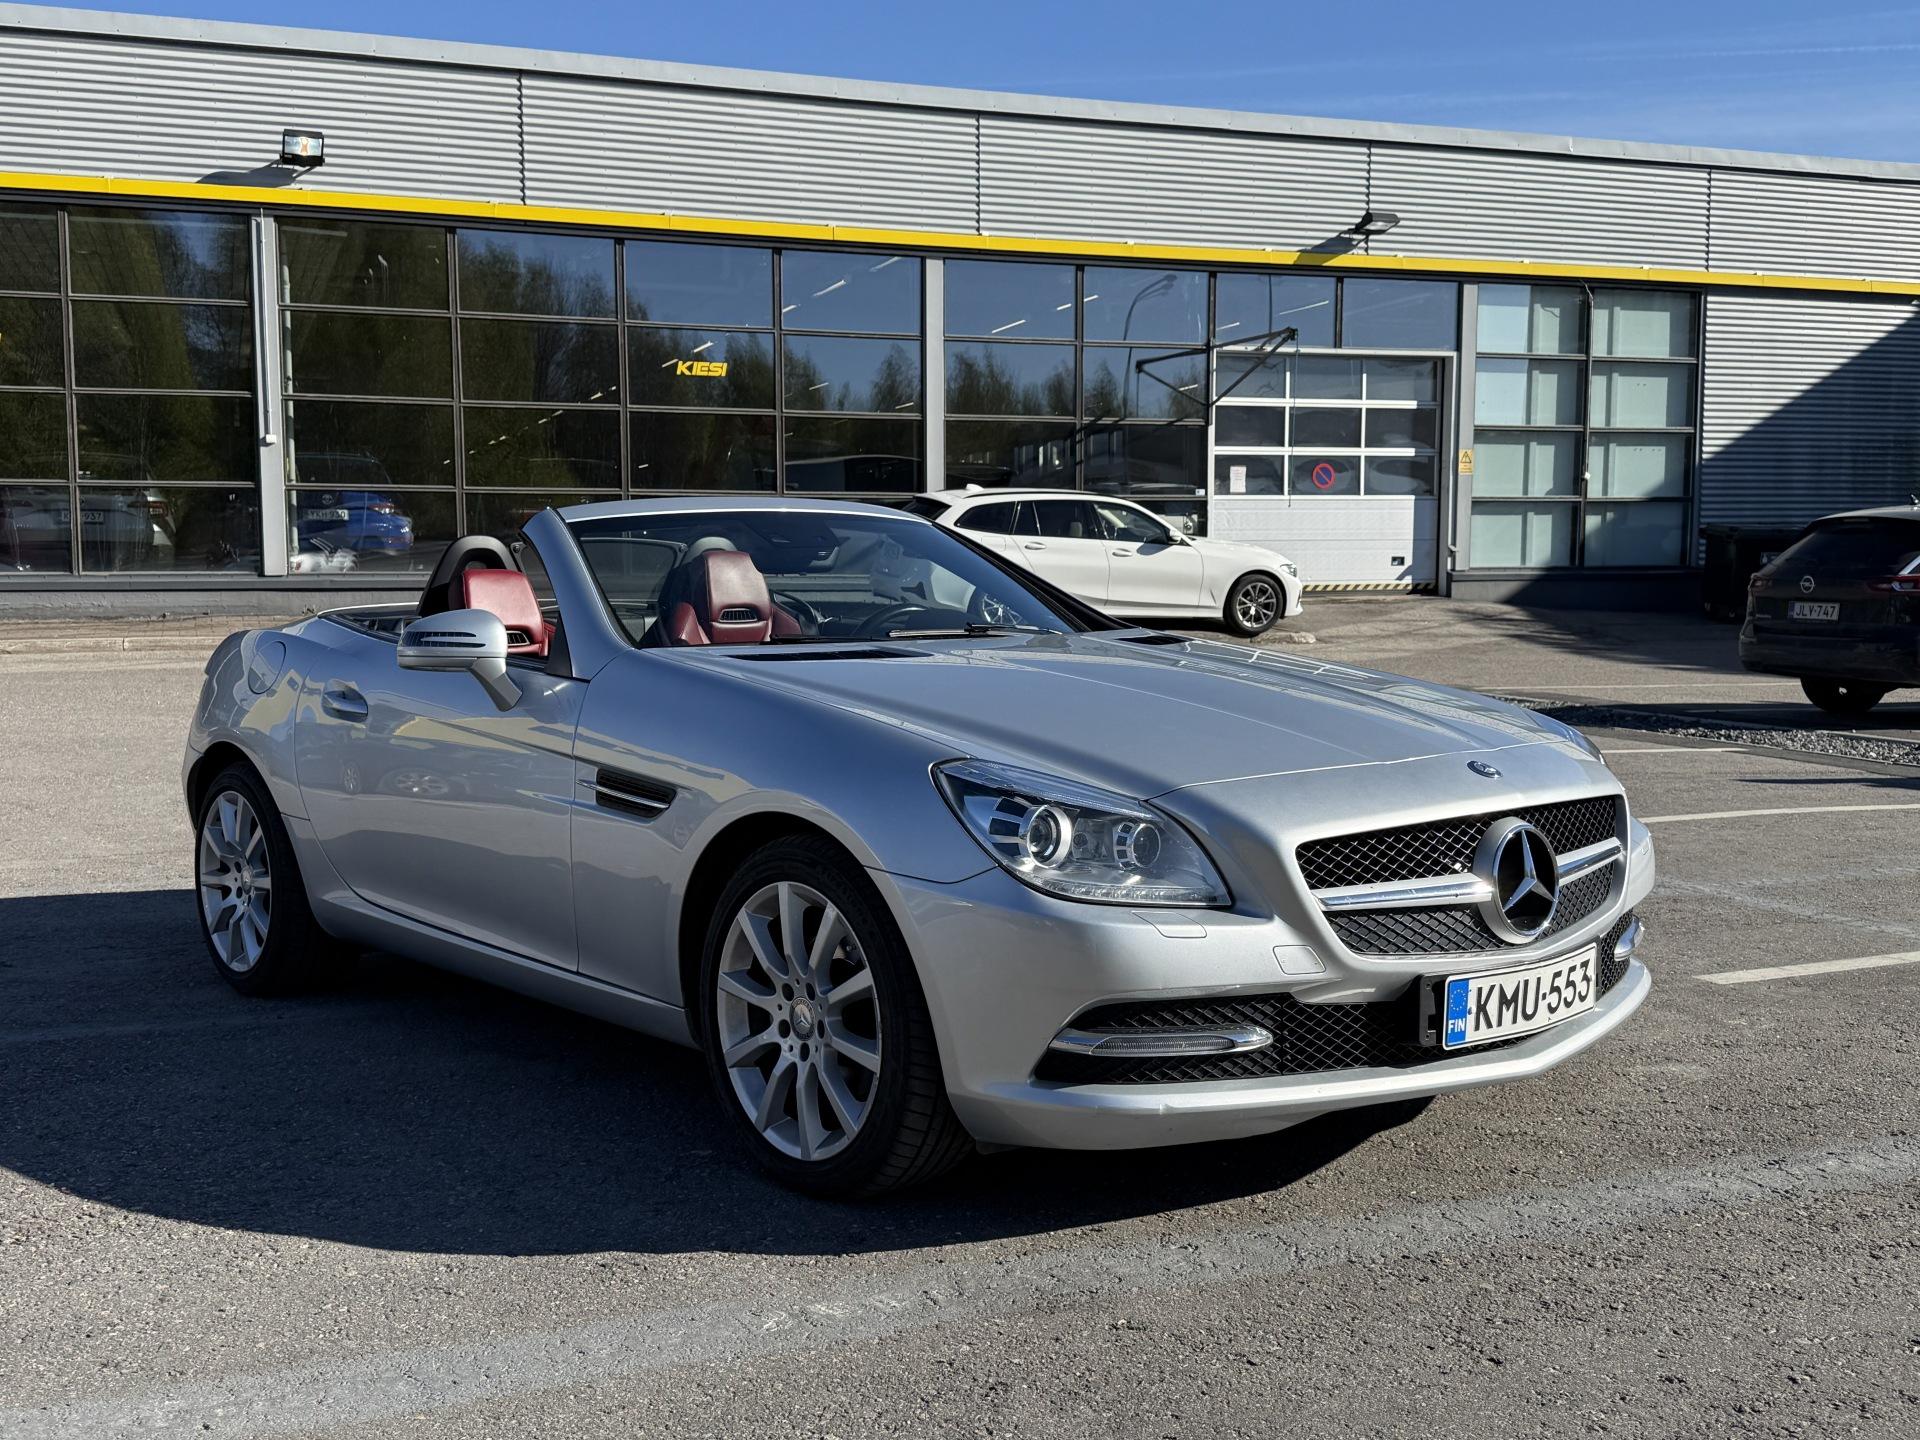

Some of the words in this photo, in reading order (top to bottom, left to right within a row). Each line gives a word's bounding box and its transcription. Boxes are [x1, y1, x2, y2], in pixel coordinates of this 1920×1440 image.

[676, 360, 728, 377] KIESI
[1795, 605, 1837, 618] JLV-747
[1473, 958, 1591, 1032] KMU-553
[1447, 1018, 1466, 1034] FIN
